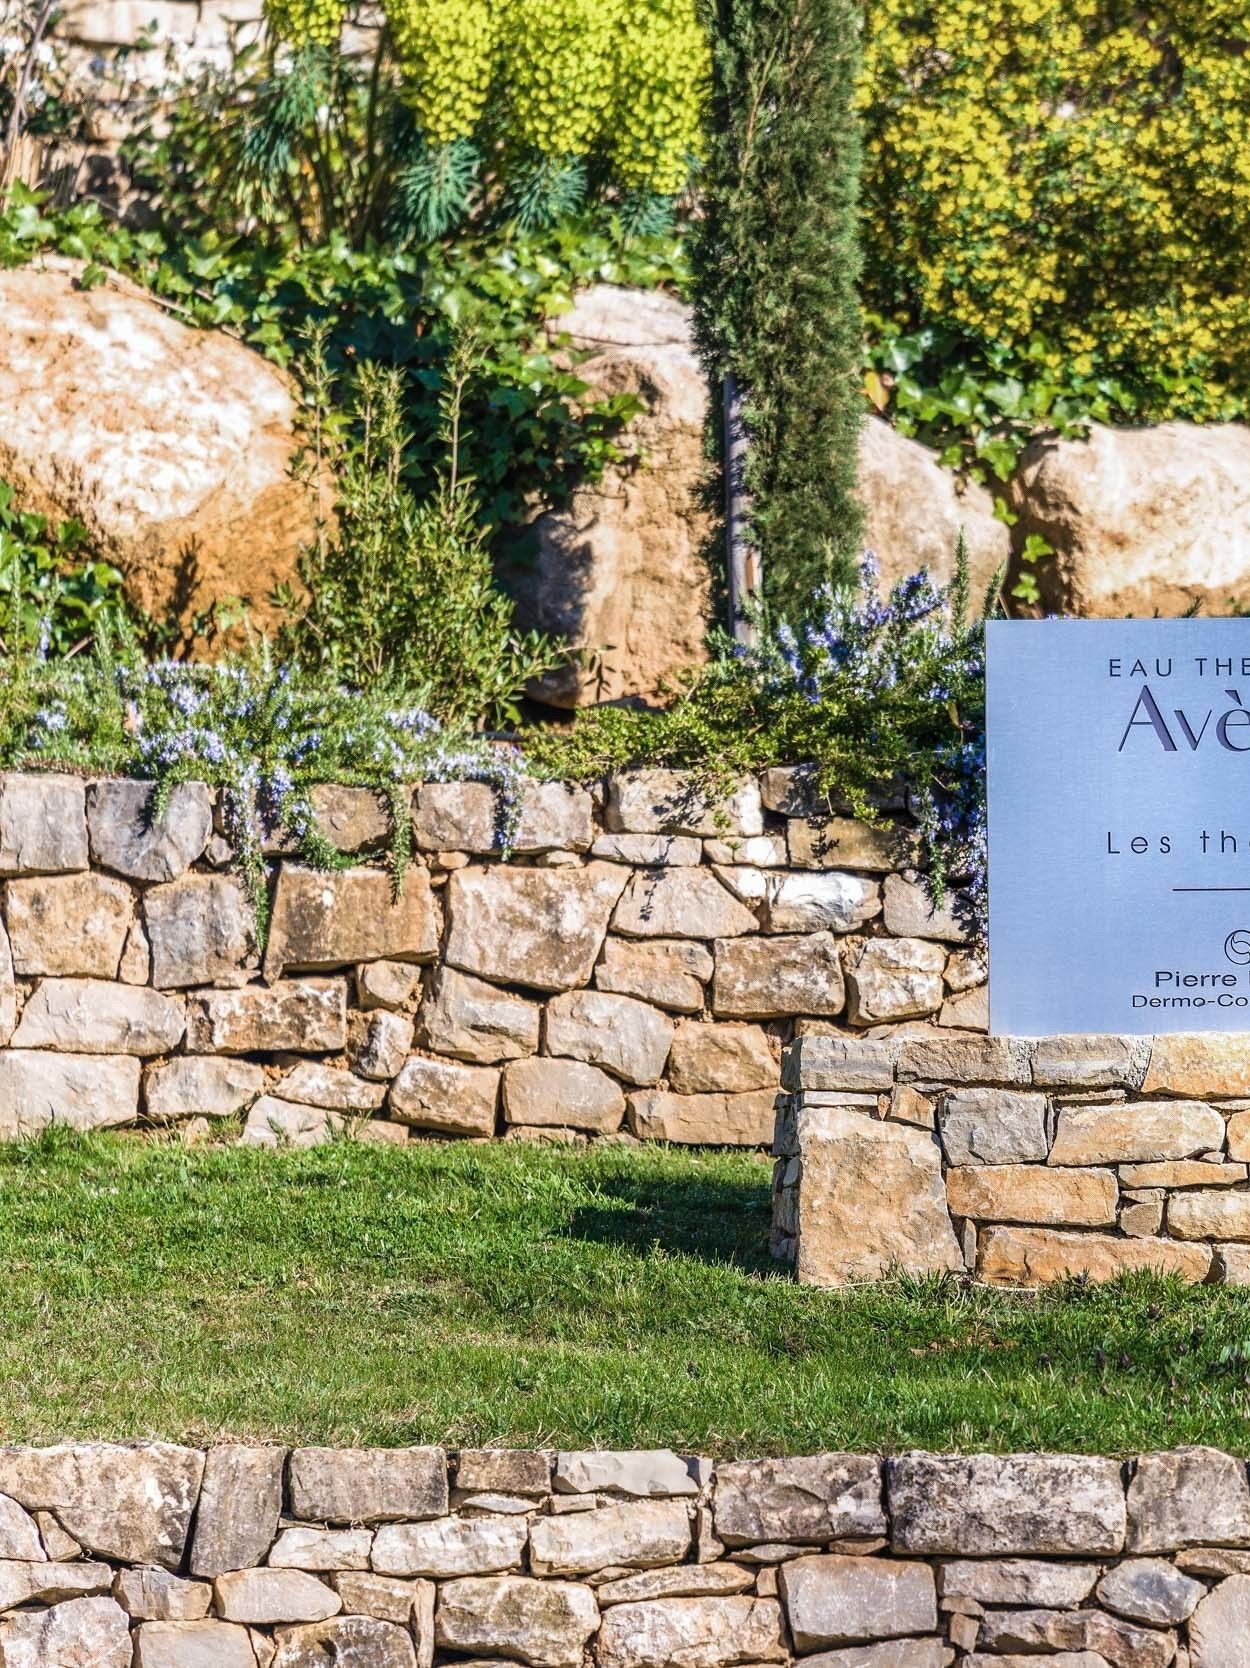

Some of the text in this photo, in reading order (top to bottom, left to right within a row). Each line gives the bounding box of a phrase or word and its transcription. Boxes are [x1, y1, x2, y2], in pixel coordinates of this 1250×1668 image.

[1108, 657, 1174, 678] EAU
[1107, 830, 1172, 855] Les
[1154, 971, 1239, 988] Pierre
